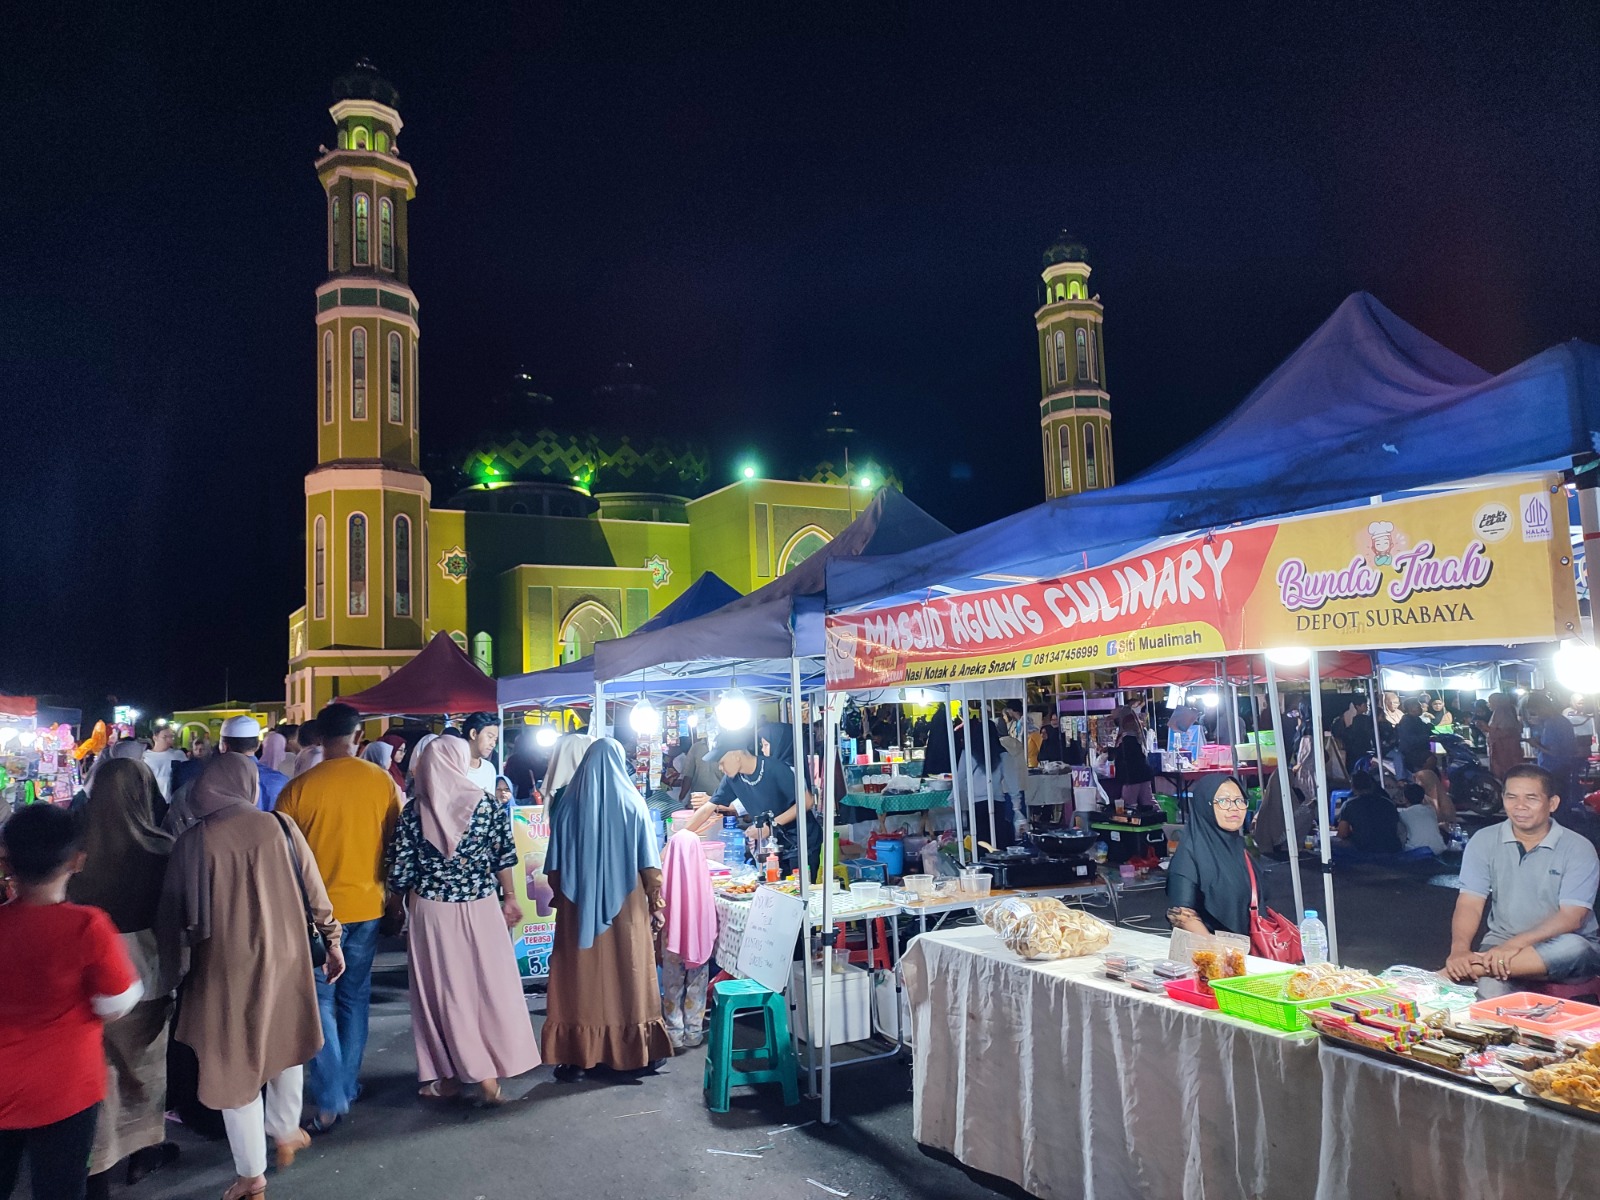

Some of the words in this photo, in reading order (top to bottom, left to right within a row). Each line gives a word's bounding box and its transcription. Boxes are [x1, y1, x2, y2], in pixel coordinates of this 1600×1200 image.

[1277, 557, 1381, 611] Bunda
[864, 606, 945, 655] MASJID
[950, 594, 1044, 645] AGUNG
[1043, 539, 1233, 629] CULINARY
[1296, 610, 1360, 632] DEPOT
[1366, 602, 1475, 628] SURABAYA
[1118, 638, 1136, 653] Siti
[1139, 630, 1202, 650] Mualimah
[1033, 645, 1099, 665] 081347456999
[904, 668, 922, 682] Nasi
[924, 666, 949, 680] Kotak
[950, 666, 956, 677] &
[957, 663, 986, 677] Aneka
[988, 658, 1017, 674] Snack
[1079, 770, 1089, 781] ICE
[529, 956, 551, 975] 5.
